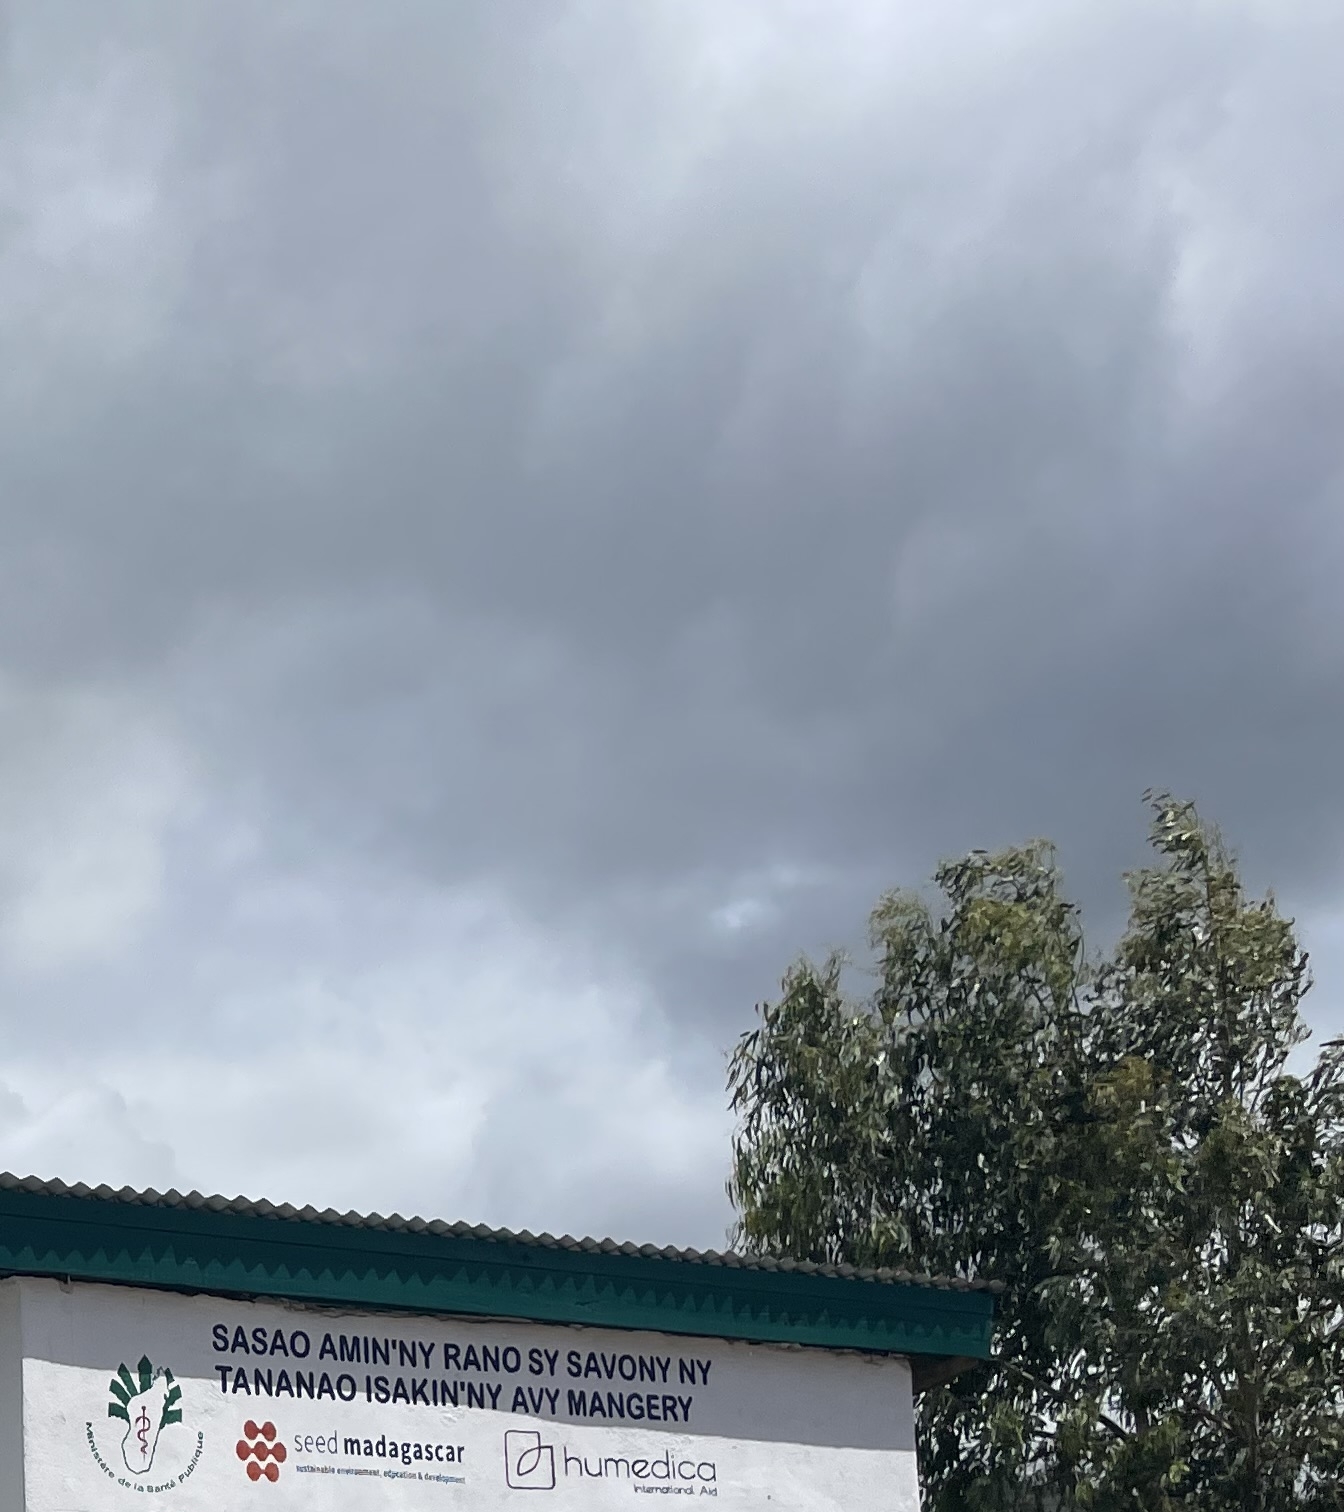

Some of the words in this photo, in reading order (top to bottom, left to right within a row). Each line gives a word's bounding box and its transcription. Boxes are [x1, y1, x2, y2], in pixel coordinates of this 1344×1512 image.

[212, 1323, 311, 1358] SASAO
[318, 1333, 435, 1370] AMIN'NY
[443, 1342, 521, 1374] RANO
[528, 1347, 559, 1376] SY
[566, 1350, 671, 1383] SAVONY
[679, 1357, 712, 1386] NY
[214, 1364, 357, 1401] TANANAO
[365, 1374, 502, 1411] ISAKIN'NY
[511, 1385, 560, 1416] AVY
[567, 1388, 693, 1422] MANGERY
[117, 1478, 131, 1489] de
[133, 1482, 144, 1492] la
[178, 1430, 204, 1484] Publique
[294, 1429, 338, 1455] seed
[343, 1434, 465, 1466] madagascar
[563, 1445, 717, 1482] humedica
[418, 1471, 423, 1480] &
[633, 1484, 695, 1496] International
[699, 1485, 718, 1496] Aid
